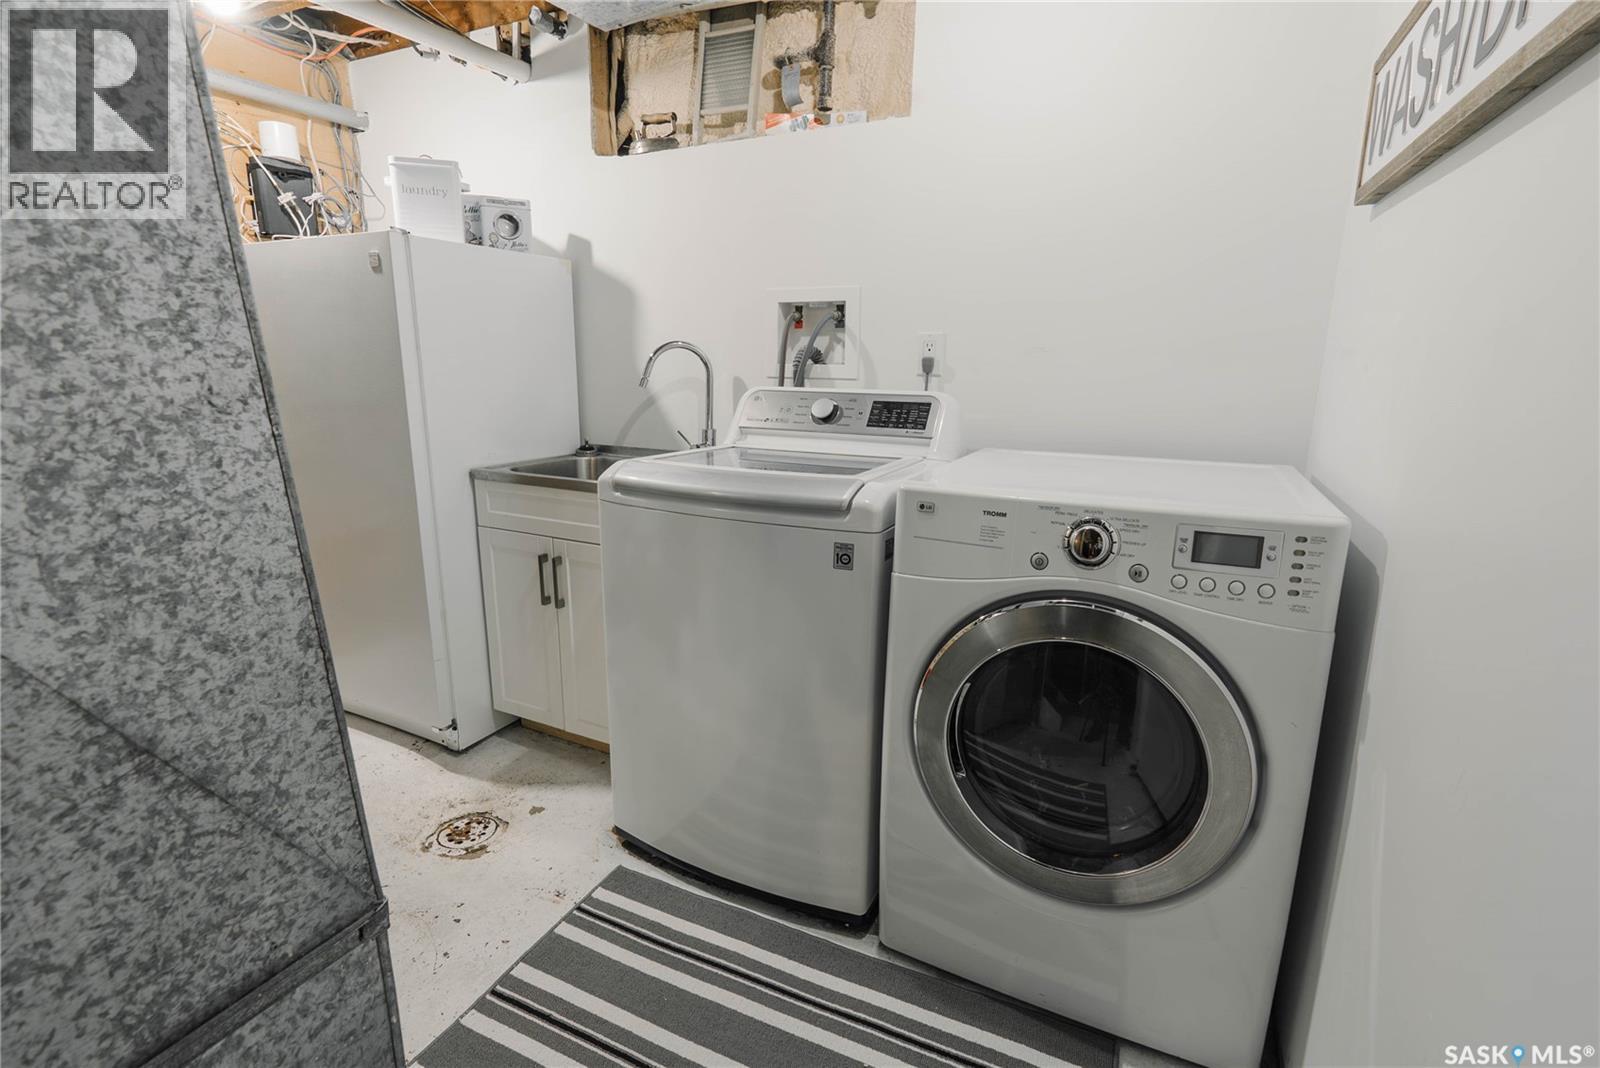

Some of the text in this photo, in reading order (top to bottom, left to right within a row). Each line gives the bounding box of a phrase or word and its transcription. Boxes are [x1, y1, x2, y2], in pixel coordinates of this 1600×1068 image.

[1368, 0, 1466, 166] WASH
[401, 183, 449, 199] laundry
[982, 510, 1007, 518] TROMM
